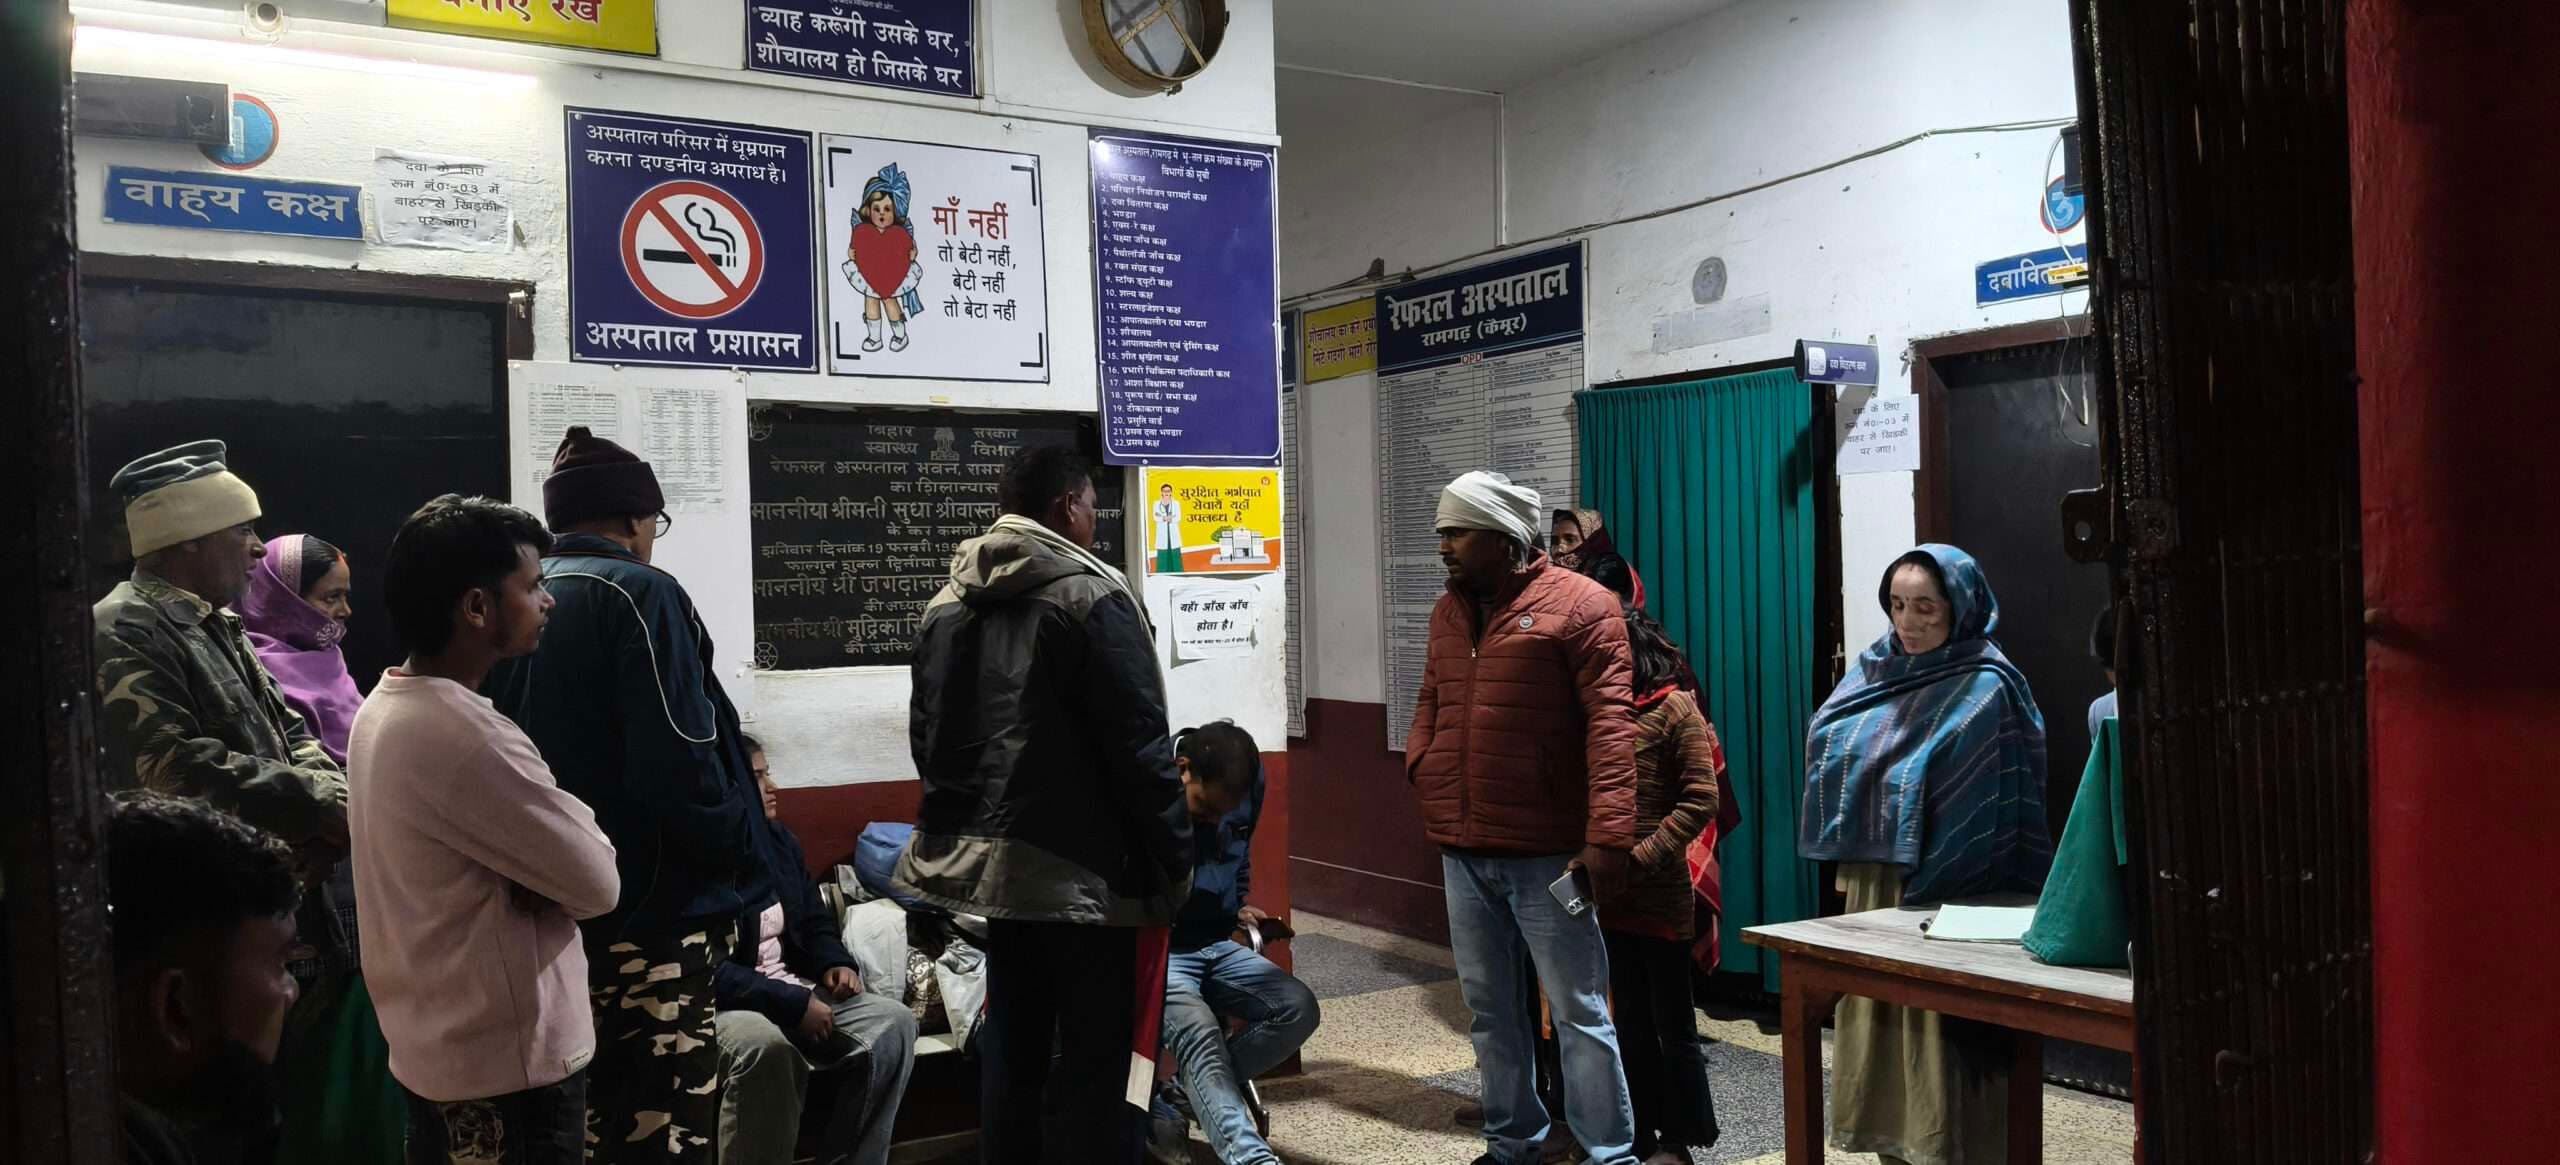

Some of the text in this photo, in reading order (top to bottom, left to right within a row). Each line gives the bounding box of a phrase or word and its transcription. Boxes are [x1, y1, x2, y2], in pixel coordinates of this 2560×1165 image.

[758, 6, 960, 58] व्याह करूँगी उसके घर,
[756, 32, 963, 88] शौचालय हो जिसके घर
[585, 124, 787, 161] अस्पताल परिसर में धूम्रपान
[585, 149, 787, 184] करना दण्डनीय अपराध है।
[264, 190, 349, 222] कक्ष
[434, 197, 447, 209] से
[932, 195, 1009, 240] माँ नहीं
[938, 240, 1018, 270] तो बेटी नहीं,
[951, 268, 1006, 295] बेटी नहीं
[1138, 291, 1154, 300] कक्ष
[1384, 265, 1570, 331] रेफरल अस्पताल
[943, 295, 1017, 323] तो बेटा नहीं
[585, 321, 803, 360] अस्पताल प्रशासन
[1421, 312, 1527, 346] रामगढ़ (कैमूर)
[1461, 352, 1483, 365] OPD
[864, 424, 1020, 440] बिहार सरकार
[864, 441, 919, 456] स्वास्थ्य
[770, 456, 826, 474] रेफरल
[833, 461, 910, 475] अस्पताल
[890, 477, 1000, 497] का शिलान्यास
[1180, 485, 1261, 500] सुरक्षित गर्भपात
[751, 496, 1004, 524] माननीया श्रीमती सुधा श्रीवास्त
[1186, 513, 1228, 523] उपलब्ध
[886, 521, 901, 537] के
[906, 526, 931, 537] कर
[761, 538, 932, 558] शनिवार दिनांक 19 फरवरी
[784, 560, 838, 575] फाल्गुन
[841, 559, 881, 576] शुक्ल
[753, 573, 828, 597] माननीय
[833, 571, 859, 595] श्री
[864, 598, 884, 612] की
[846, 613, 902, 641] मुद्रिका
[1196, 619, 1218, 632] होता
[845, 638, 867, 655] की
